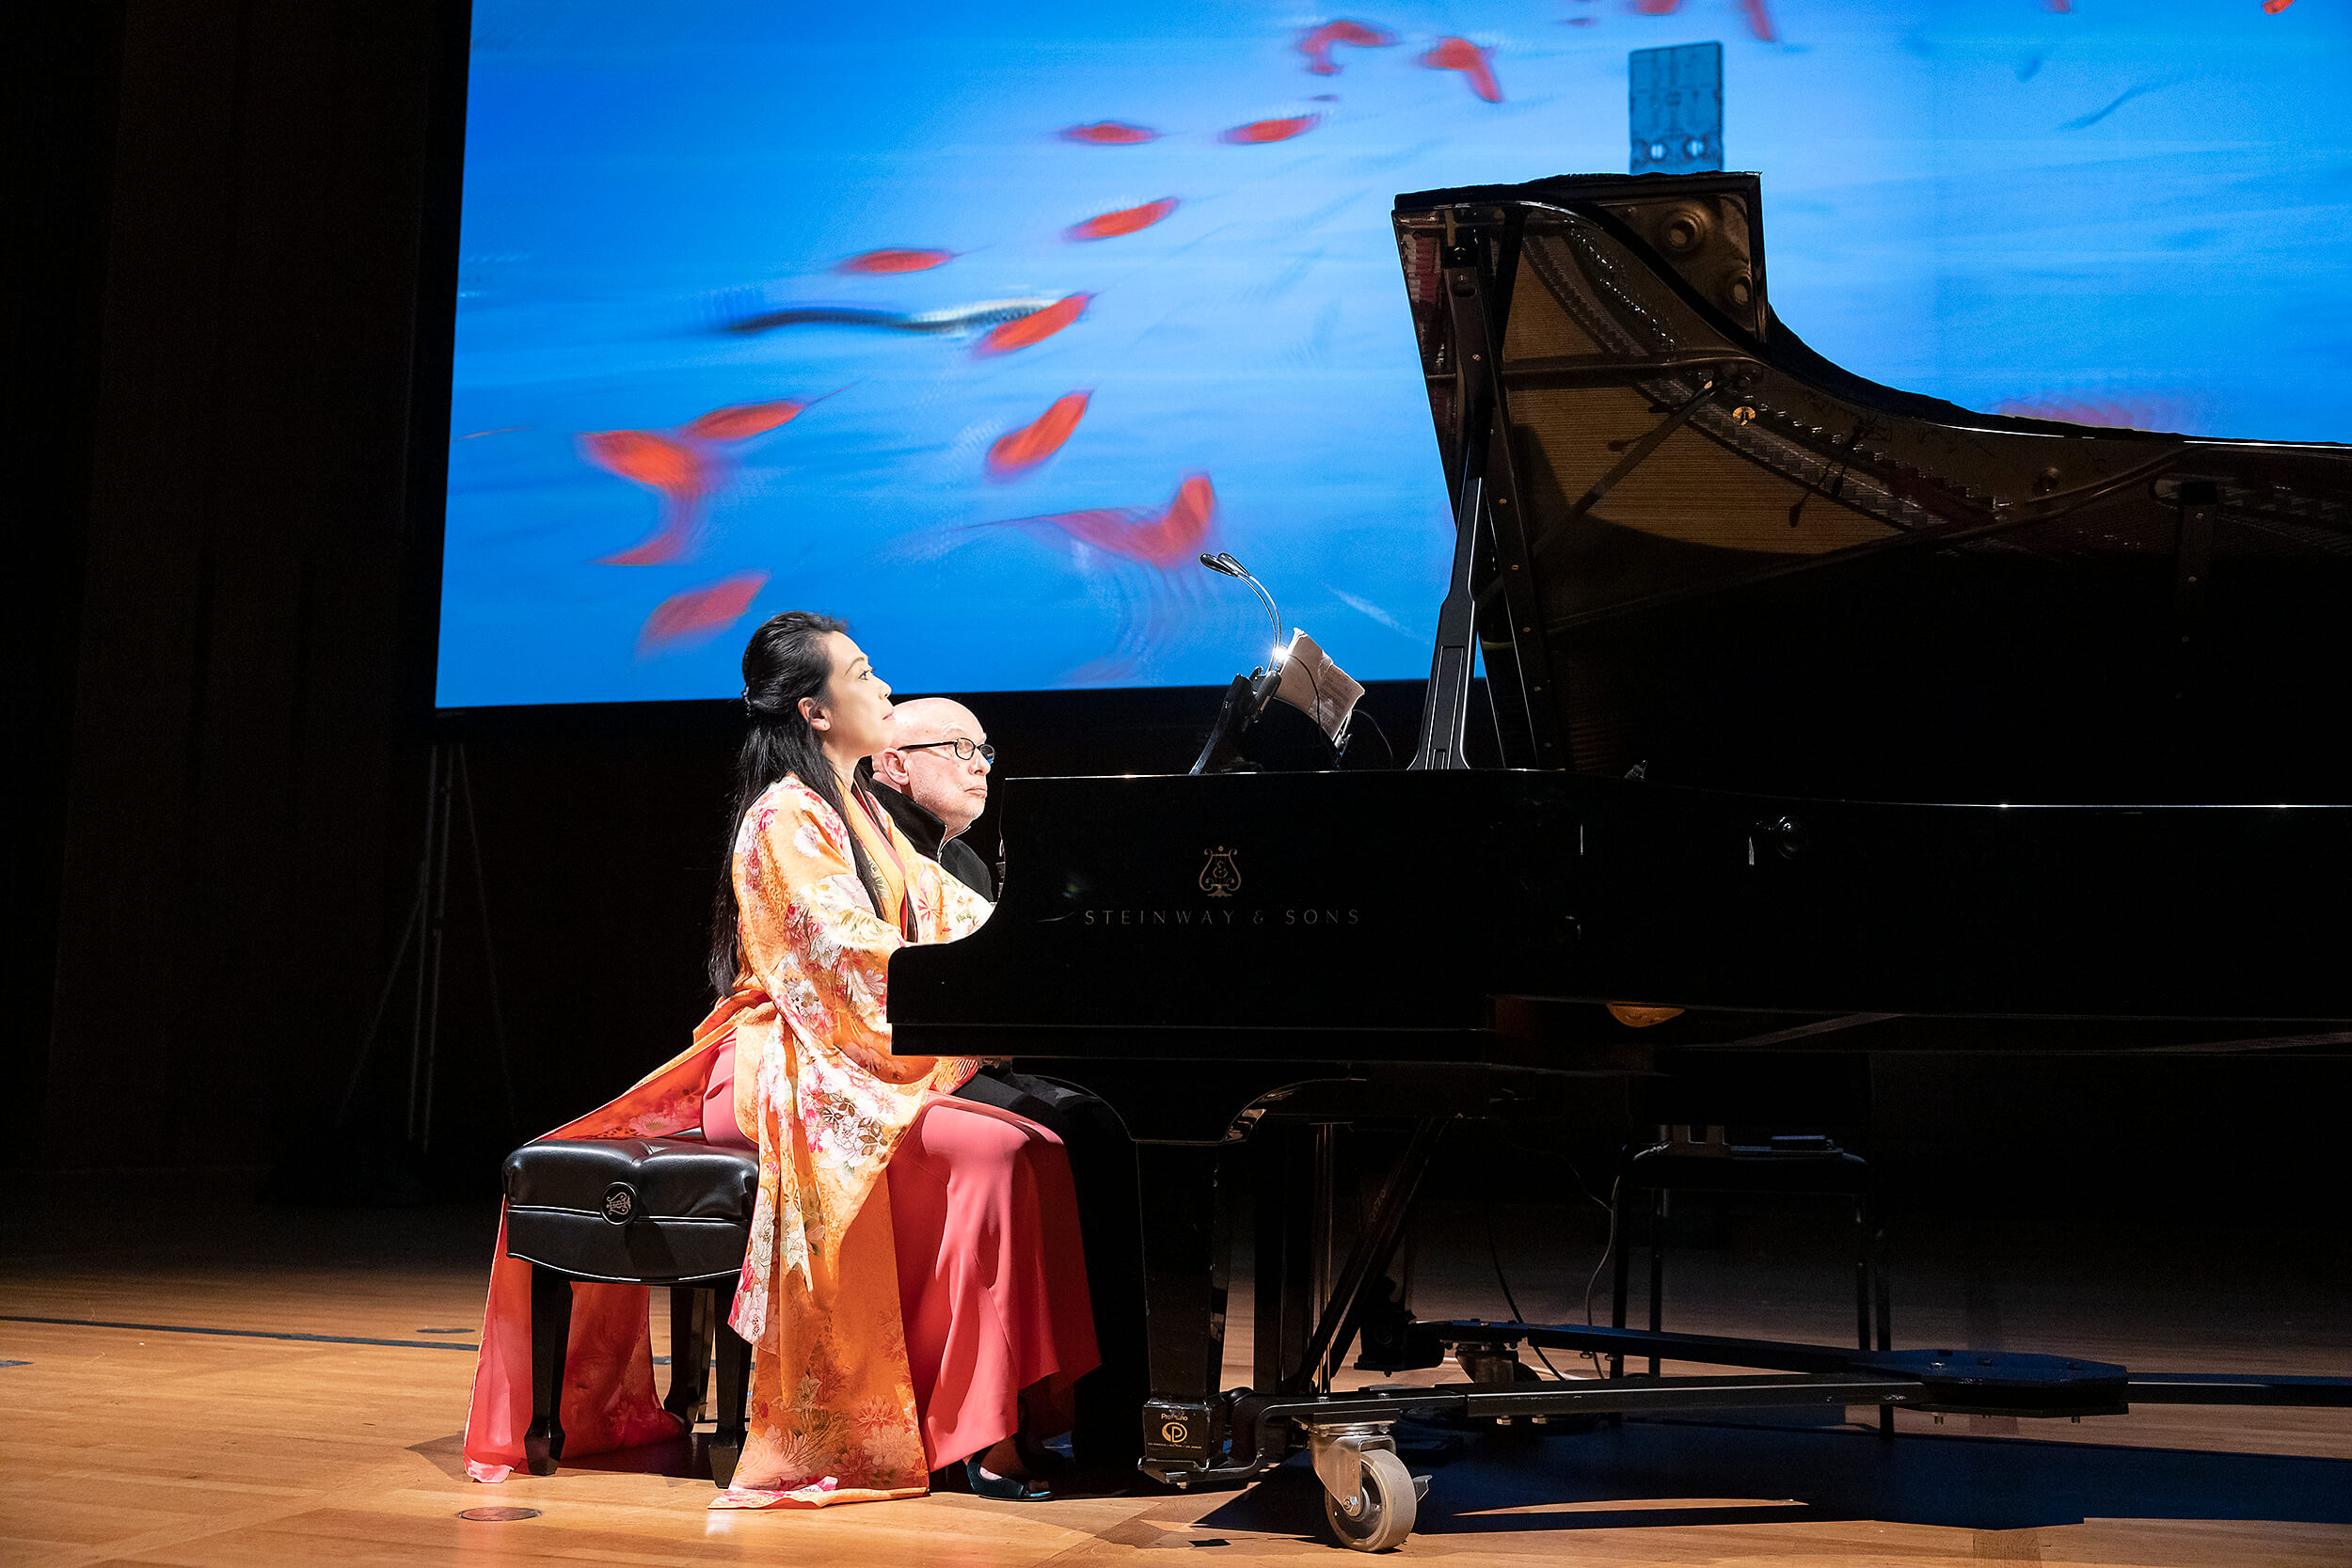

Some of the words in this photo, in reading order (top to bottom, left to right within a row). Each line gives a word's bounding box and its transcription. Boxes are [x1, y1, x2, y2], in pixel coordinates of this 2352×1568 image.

[1084, 910, 1235, 926] STEINWAY
[1252, 911, 1265, 926] &
[1285, 909, 1360, 926] SONS
